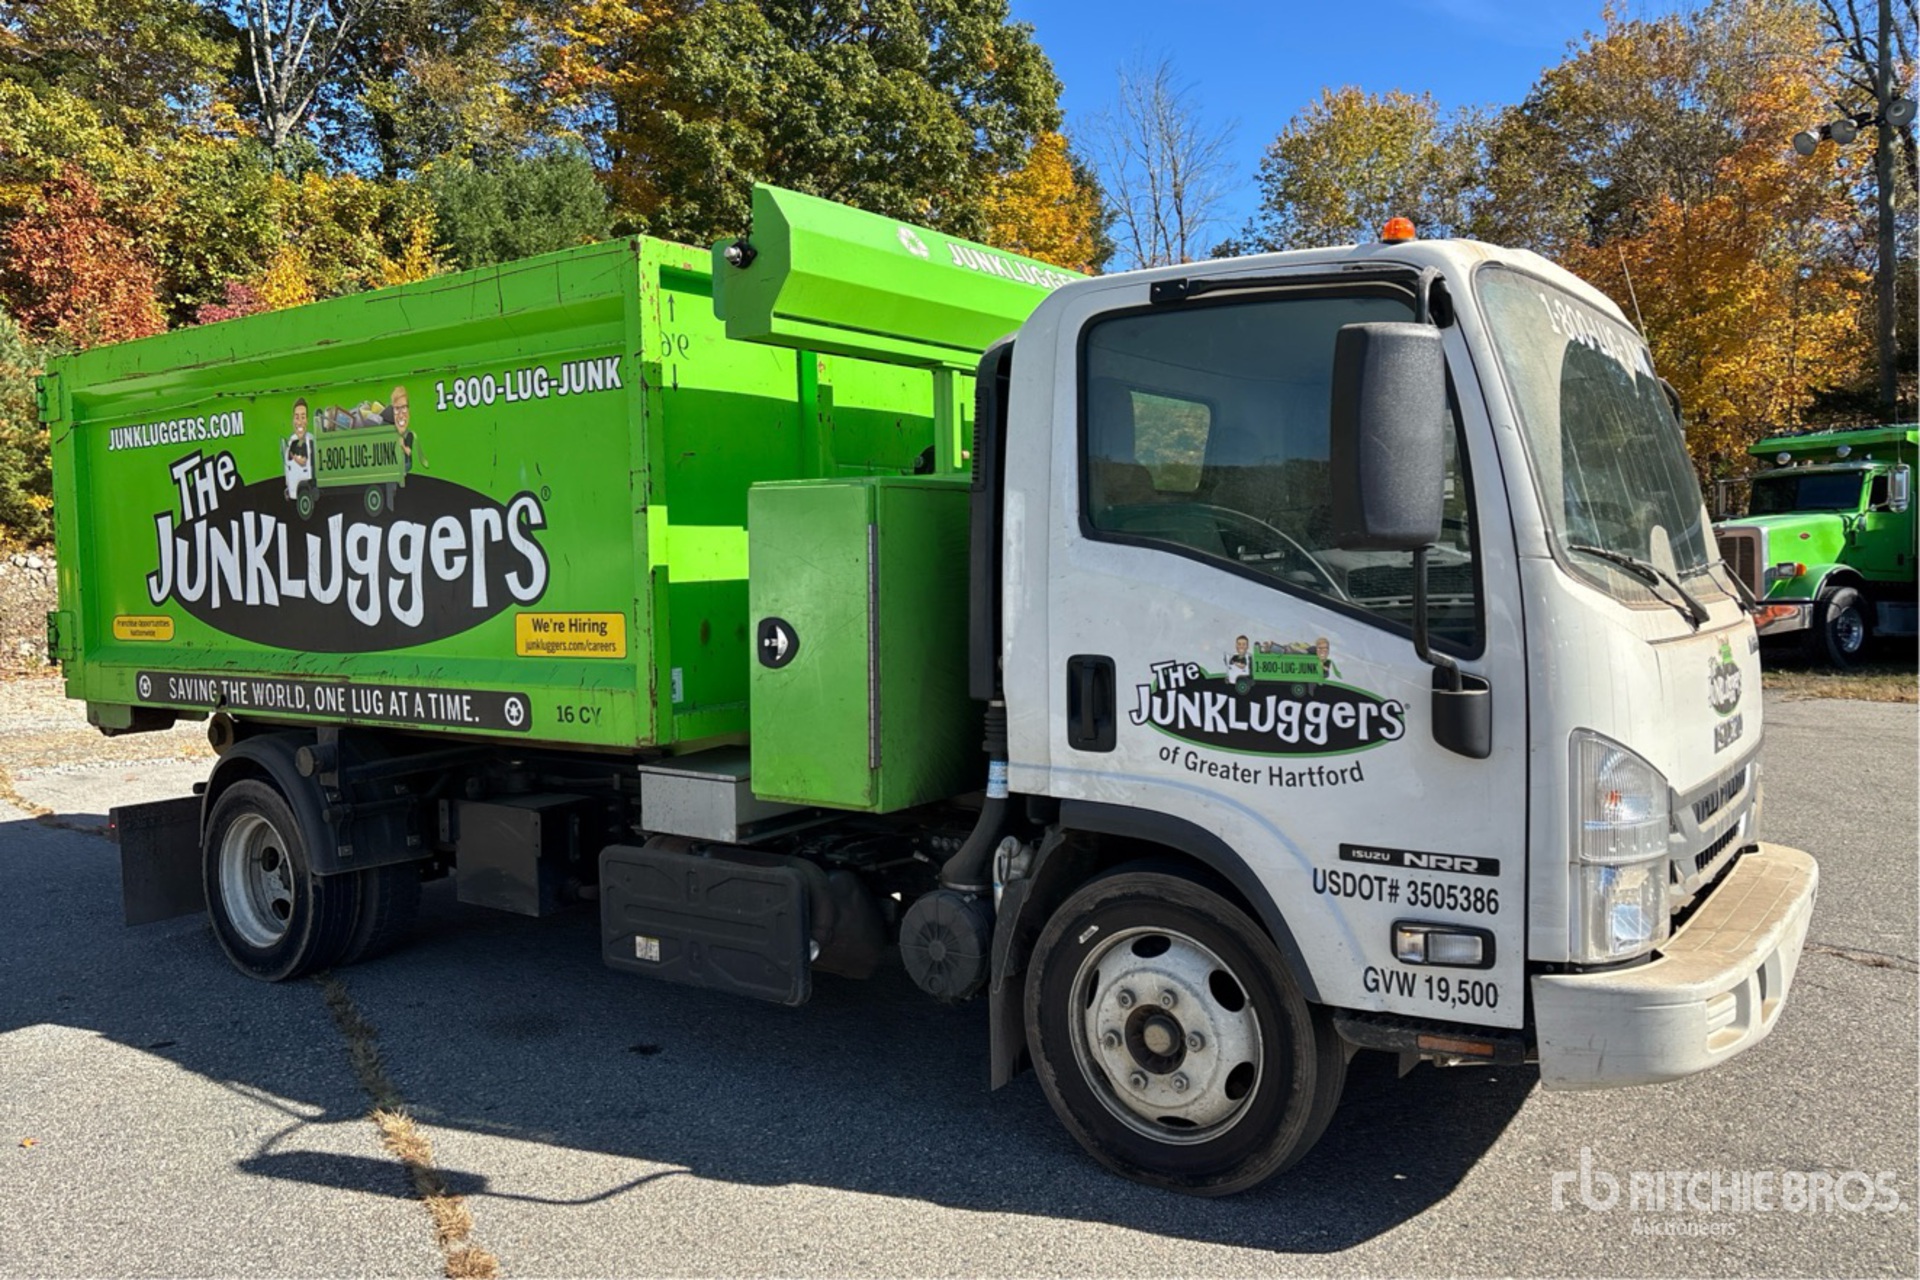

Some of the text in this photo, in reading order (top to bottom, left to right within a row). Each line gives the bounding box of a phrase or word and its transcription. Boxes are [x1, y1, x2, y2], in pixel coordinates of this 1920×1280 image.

[435, 355, 623, 412] 1-800-LUG-JUNK
[108, 411, 244, 450] JUNKLUGGERS.COM
[317, 440, 399, 471] 1-800-LUG-JUNK
[531, 618, 608, 637] We're Hiring
[525, 639, 617, 654] junkluggers.com/careers
[1254, 658, 1319, 676] 1-800-LUG-JUNK
[169, 677, 481, 724] SAVING THE WORLD, ONE LUG AT A TIME.
[556, 704, 602, 728] 16 CY
[1158, 745, 1364, 788] of Greater Hartford
[1351, 849, 1479, 873] ISUZU NRR
[1312, 867, 1500, 915] USDOT# 3505386
[1363, 965, 1499, 1009] GVW 19,500
